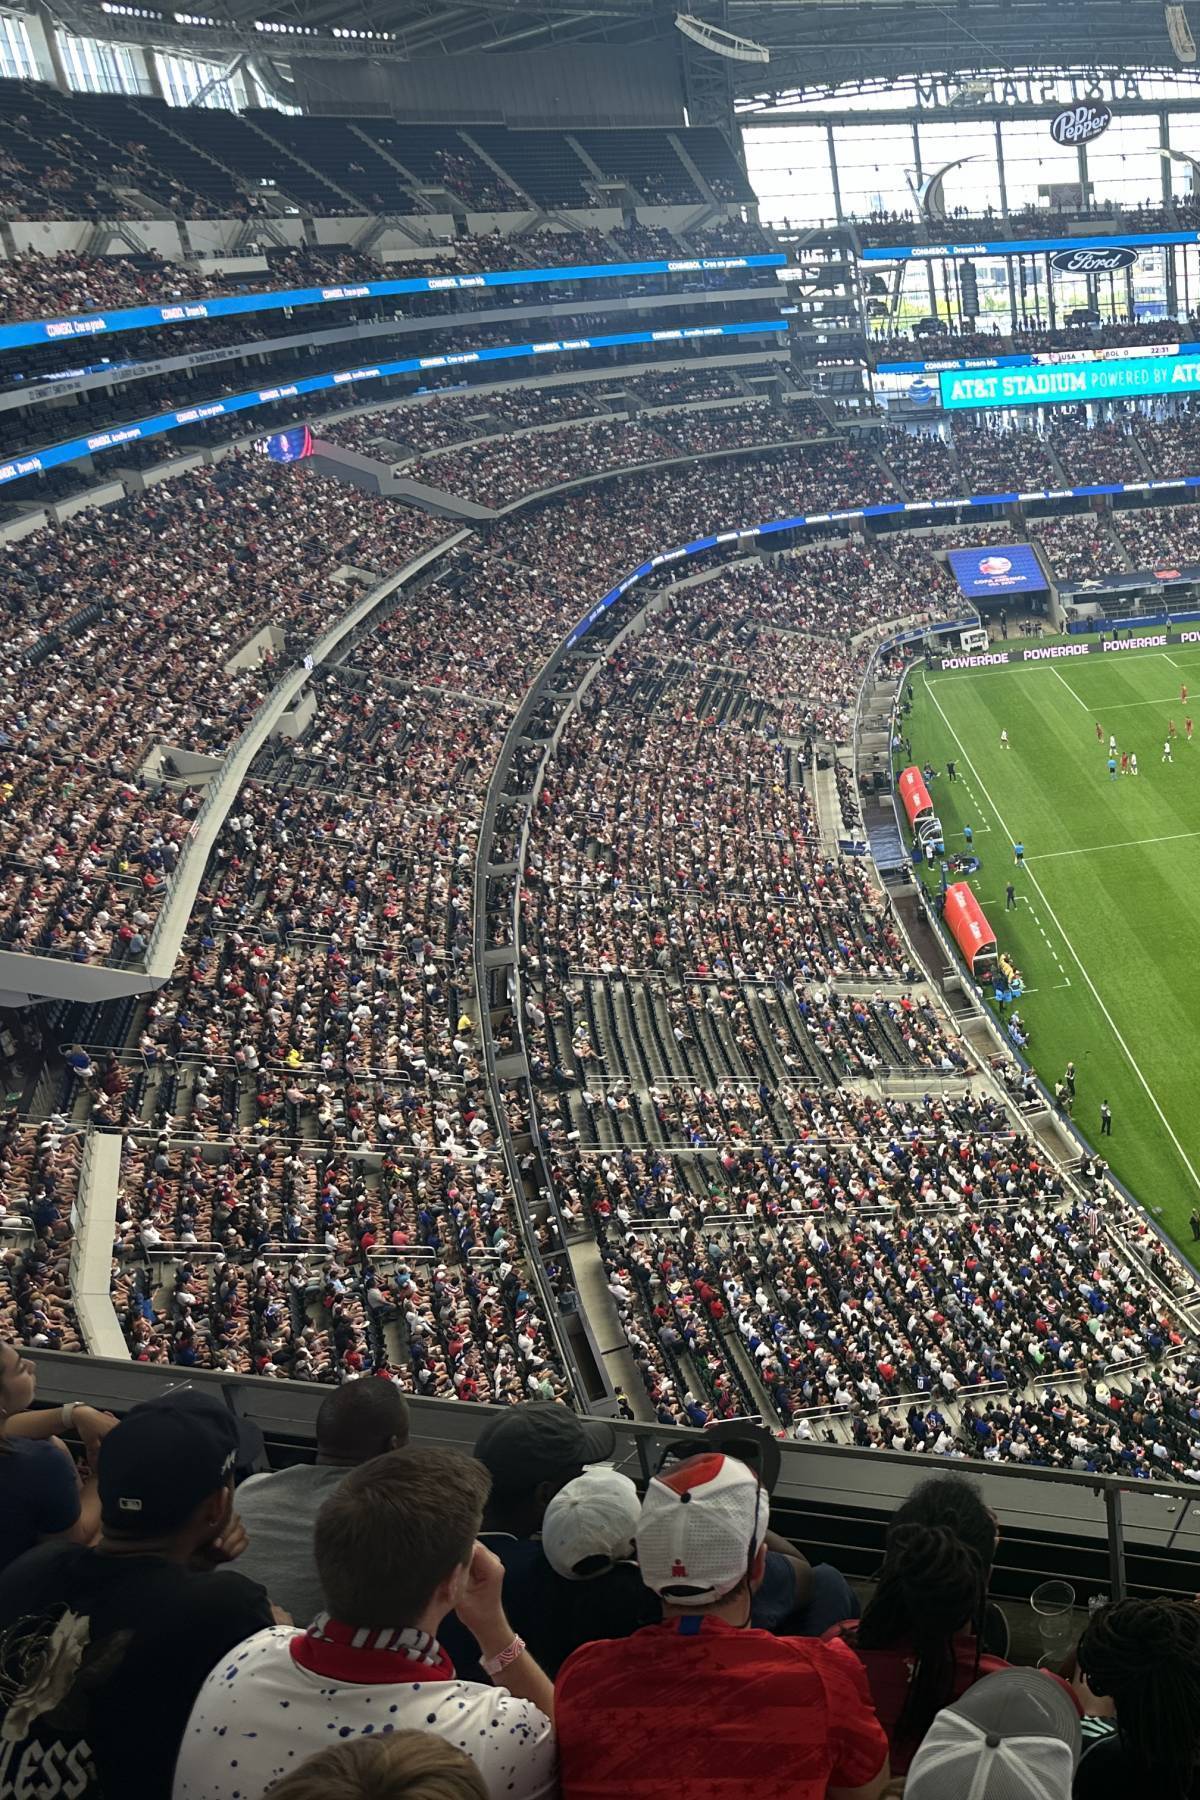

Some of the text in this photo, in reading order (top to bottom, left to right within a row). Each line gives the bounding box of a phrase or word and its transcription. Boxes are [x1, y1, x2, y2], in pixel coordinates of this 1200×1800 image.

[1076, 107, 1096, 123] Dr
[1053, 111, 1108, 141] Pepper
[912, 247, 949, 256] CONMEBOL
[1067, 250, 1122, 270] Ford
[1061, 353, 1076, 361] USA
[1105, 350, 1119, 358] BOL
[1151, 346, 1169, 354] 22:31
[925, 360, 960, 370] CONMEBOL
[951, 378, 1000, 400] AT&T
[1002, 372, 1087, 396] STADIUM
[1091, 372, 1149, 387] POWERED
[1153, 369, 1167, 380] BY
[1103, 634, 1168, 652] POWERADE
[1023, 643, 1089, 661] POWERADE
[942, 653, 1009, 670] POWERADE
